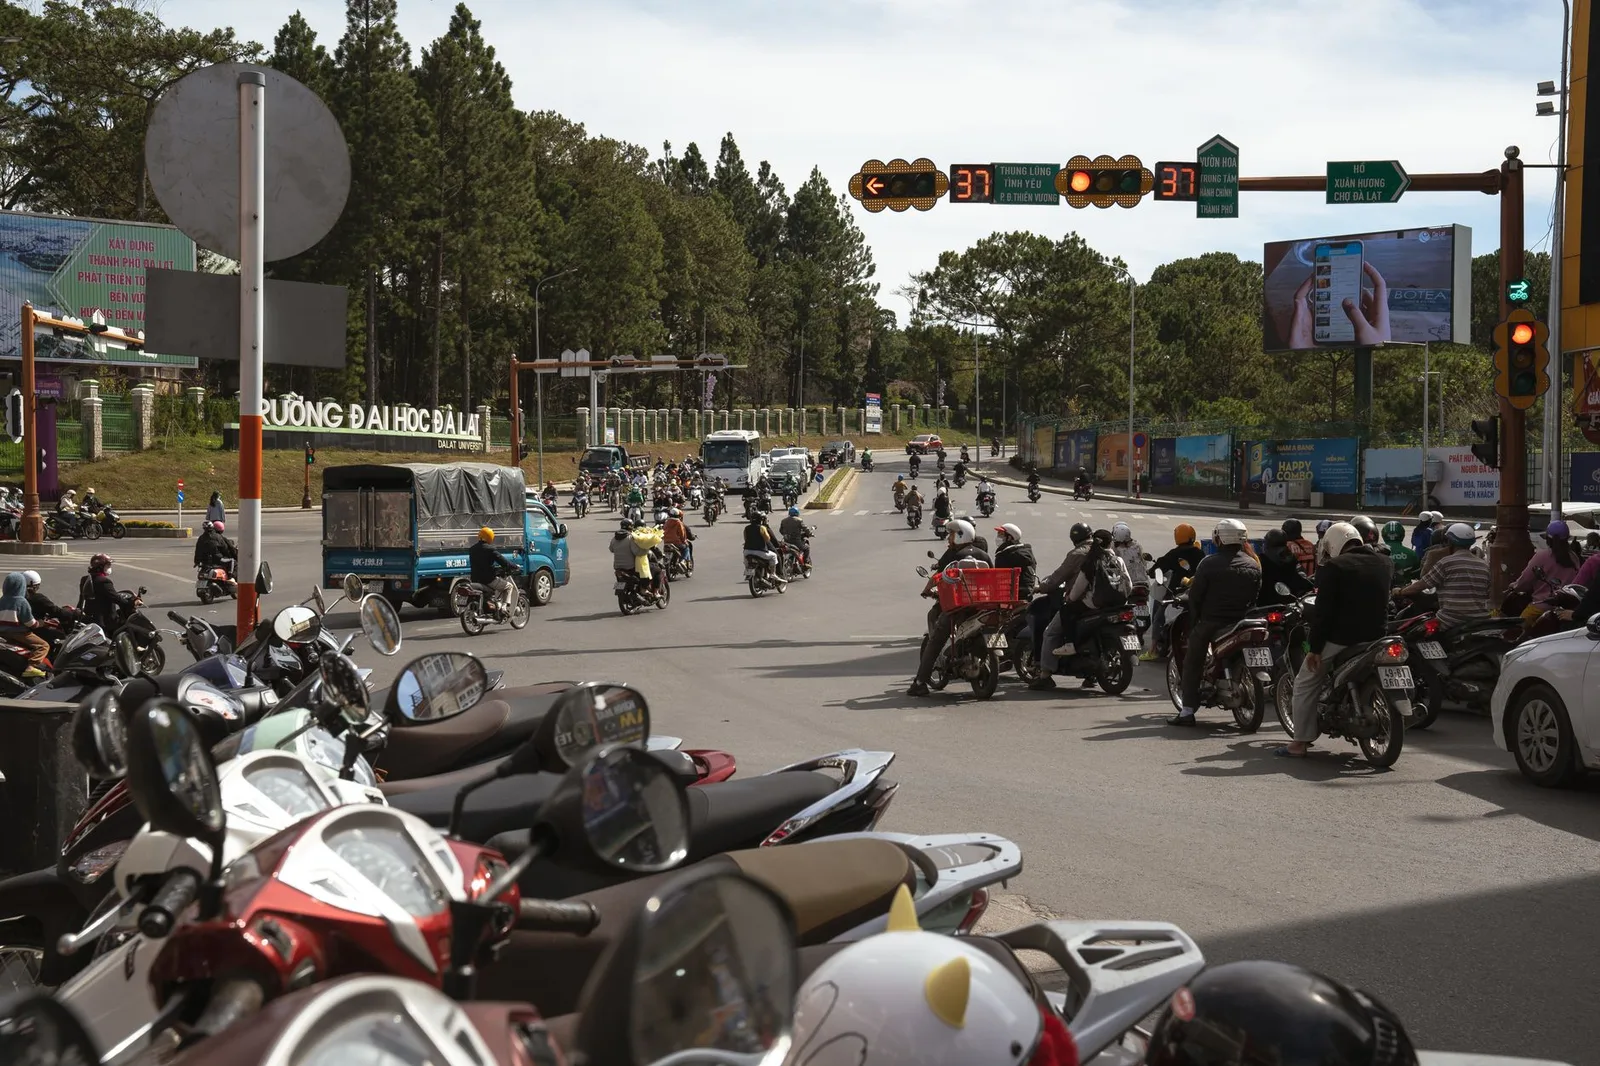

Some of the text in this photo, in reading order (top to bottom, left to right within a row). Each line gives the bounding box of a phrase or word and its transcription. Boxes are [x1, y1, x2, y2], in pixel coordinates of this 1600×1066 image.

[1222, 157, 1237, 168] HOA
[1353, 162, 1366, 174] HỒ
[1000, 165, 1052, 177] THUNG LŨNG
[958, 169, 990, 198] 37
[1004, 176, 1042, 189] TÌNH YÊU
[1162, 167, 1195, 196] 37
[1200, 172, 1237, 184] TRUNG TÂM
[1334, 176, 1386, 188] XUÂN HƯƠNG
[1034, 192, 1058, 202] VƯƠNG
[1216, 186, 1232, 198] CHÍNH
[1334, 189, 1382, 202] CHỢ ĐÀ LẠT
[1200, 202, 1220, 214] THÀNH
[108, 237, 126, 250] XÂY
[78, 270, 102, 283] PHÁT
[1394, 290, 1446, 300] BOTEA
[262, 392, 343, 428] RƯỜNG
[438, 440, 484, 451] DALAT UNIVERSITY
[1278, 460, 1312, 472] HAPPY
[1276, 470, 1314, 481] COMBO
